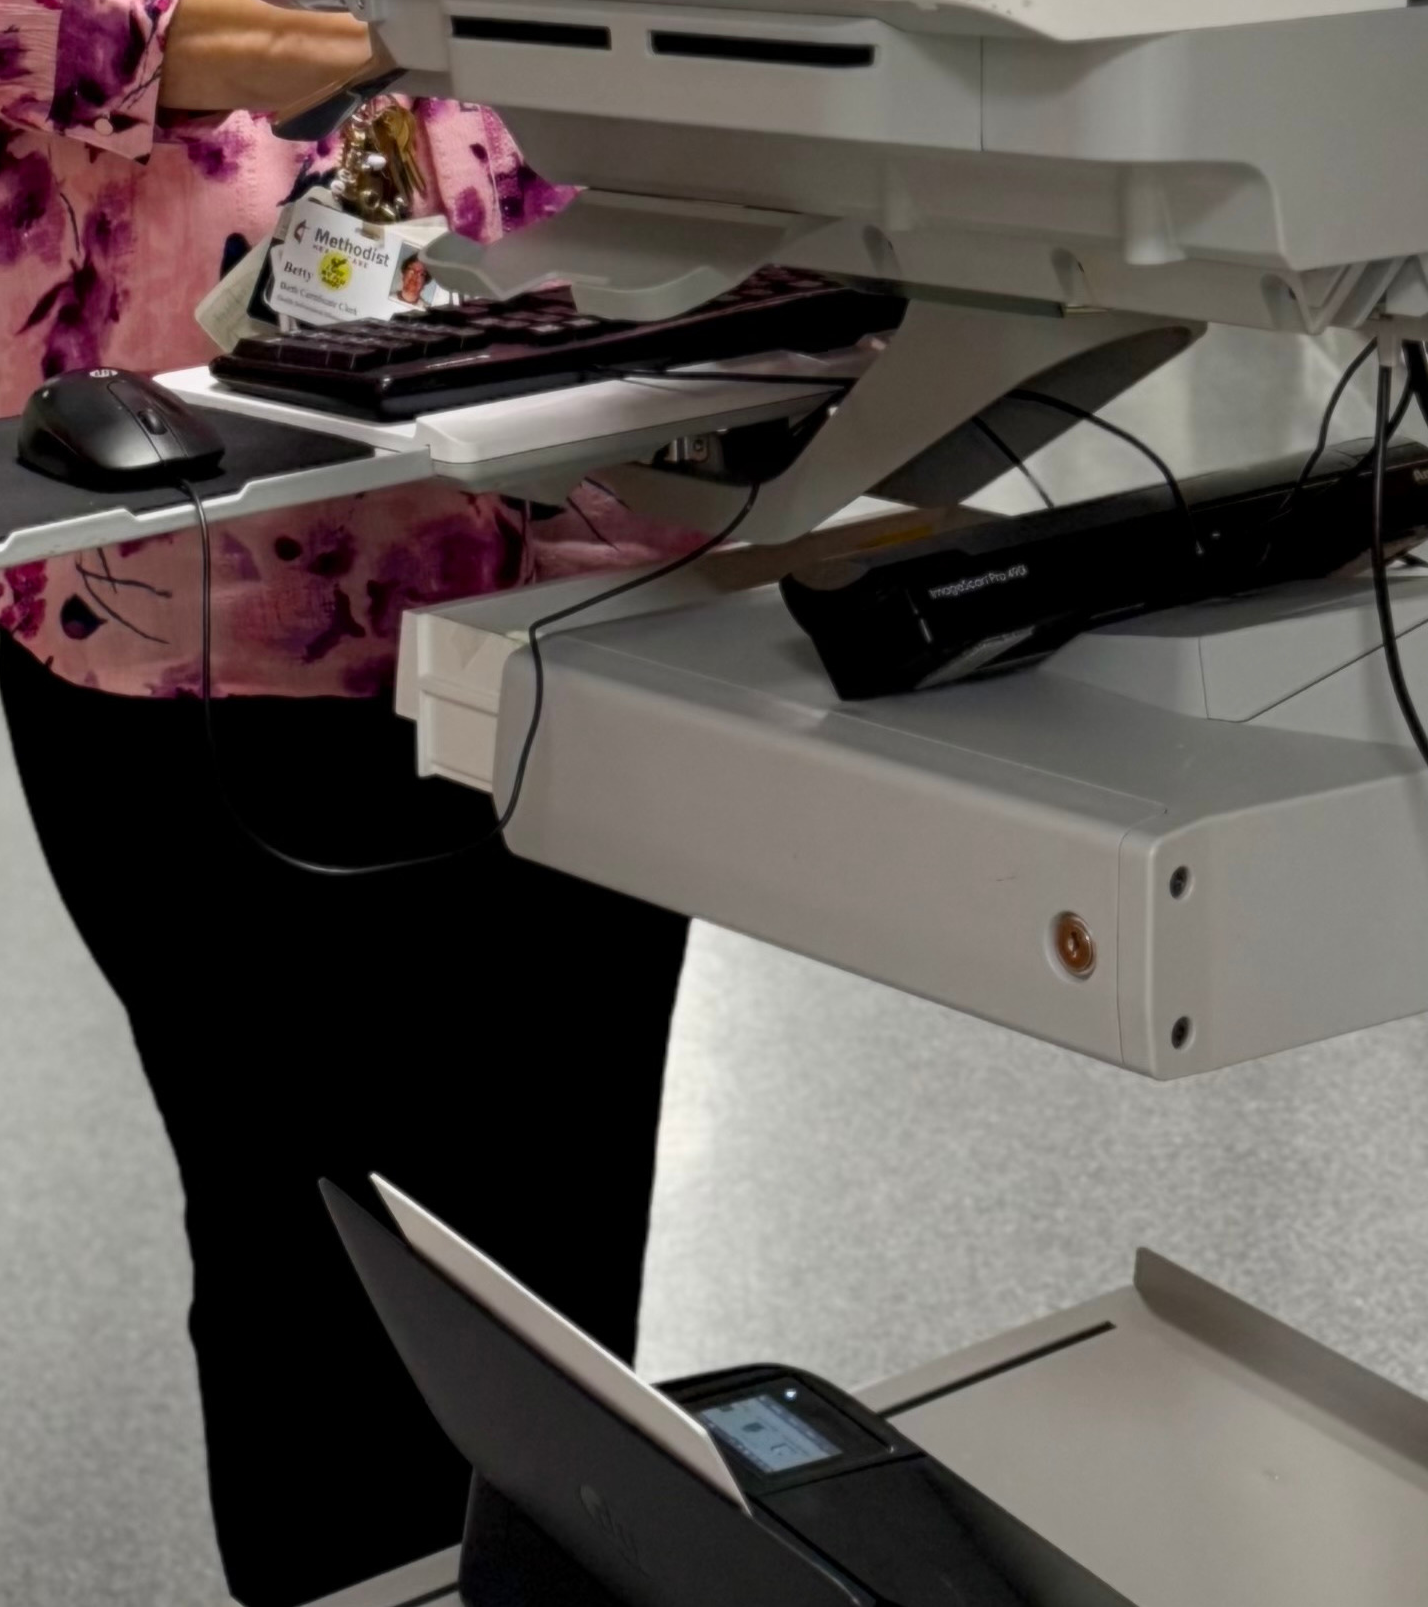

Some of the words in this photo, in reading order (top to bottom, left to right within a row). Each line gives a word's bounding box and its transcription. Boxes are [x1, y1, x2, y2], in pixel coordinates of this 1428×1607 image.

[314, 227, 391, 268] Methodist
[283, 261, 314, 283] Betty
[928, 574, 990, 600] ImageScan
[988, 571, 1007, 584] Pro
